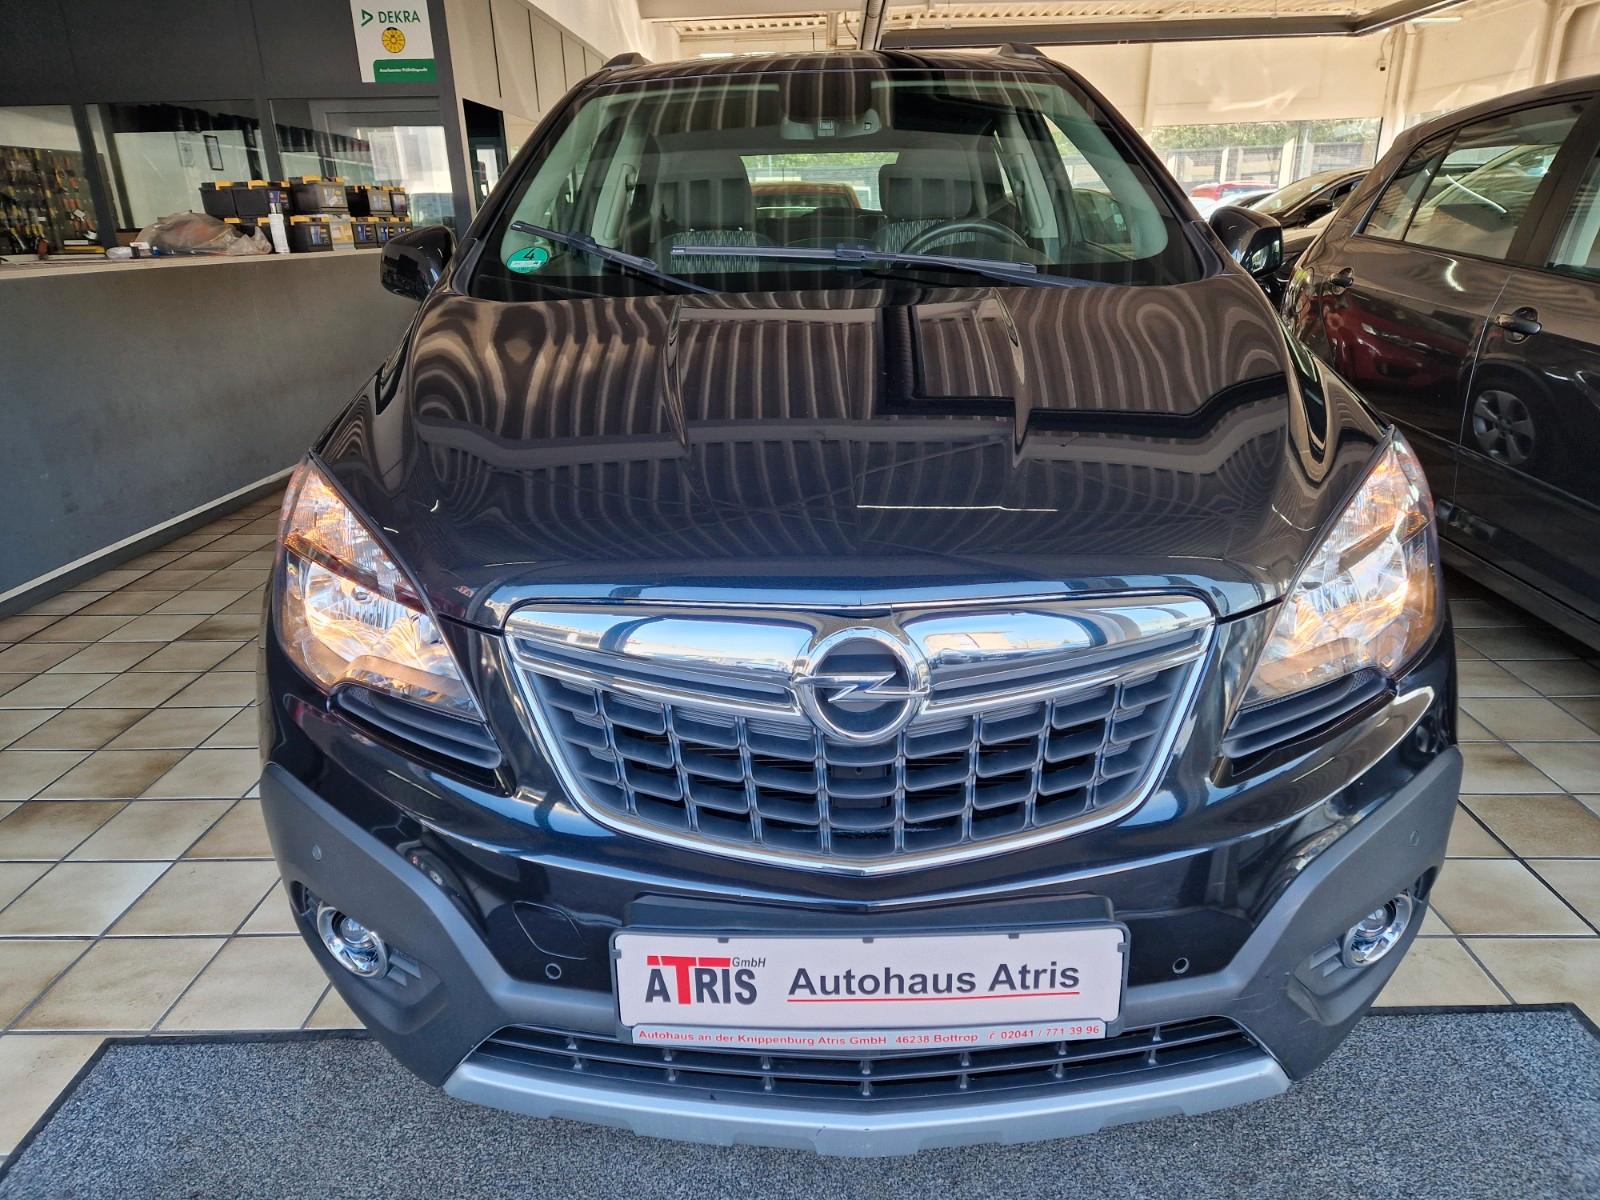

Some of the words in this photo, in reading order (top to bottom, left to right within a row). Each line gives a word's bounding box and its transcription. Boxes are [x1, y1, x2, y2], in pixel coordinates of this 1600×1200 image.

[378, 10, 421, 23] DEKRA
[732, 957, 766, 968] GmbH
[645, 955, 757, 1005] ATRIS
[788, 966, 976, 996] Autohaus
[988, 961, 1080, 992] Atris
[639, 1030, 694, 1041] Autohaus
[715, 1033, 733, 1042] der
[738, 1034, 815, 1047] Knippenburg
[818, 1036, 845, 1045] Atris
[850, 1036, 887, 1045] GmbH
[895, 1034, 930, 1044] 46238
[934, 1033, 978, 1043] Bottrop
[1001, 1030, 1034, 1040] 02041
[1046, 1028, 1064, 1037] 771
[1070, 1026, 1083, 1035] 39
[1086, 1025, 1100, 1034] 96
